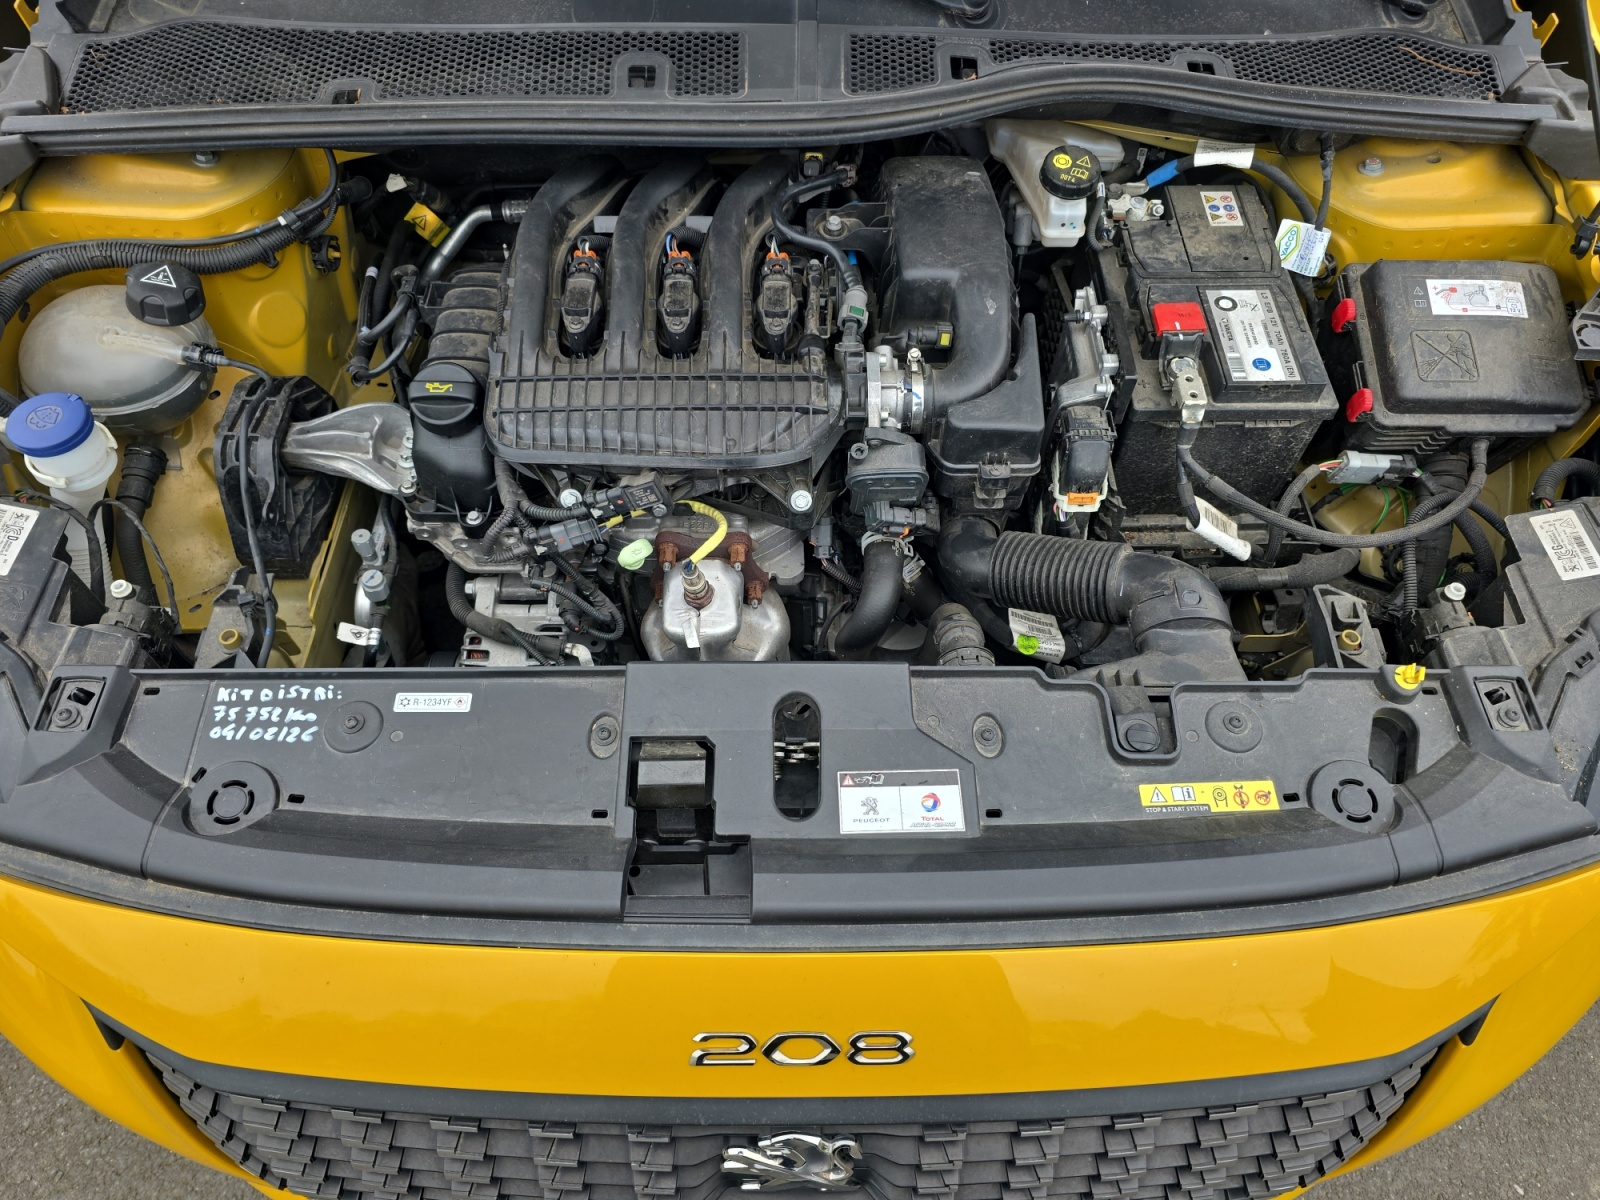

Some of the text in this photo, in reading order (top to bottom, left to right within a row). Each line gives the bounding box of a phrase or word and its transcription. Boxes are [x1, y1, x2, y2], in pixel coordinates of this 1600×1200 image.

[1280, 228, 1297, 258] YACCO
[1224, 324, 1234, 341] VARTA
[1264, 302, 1273, 313] EFB
[1269, 317, 1278, 327] 12V
[1274, 331, 1284, 345] 70Ah
[1286, 366, 1296, 378] (EN)
[413, 698, 452, 706] R-1234YF
[688, 1030, 916, 1067] 208
